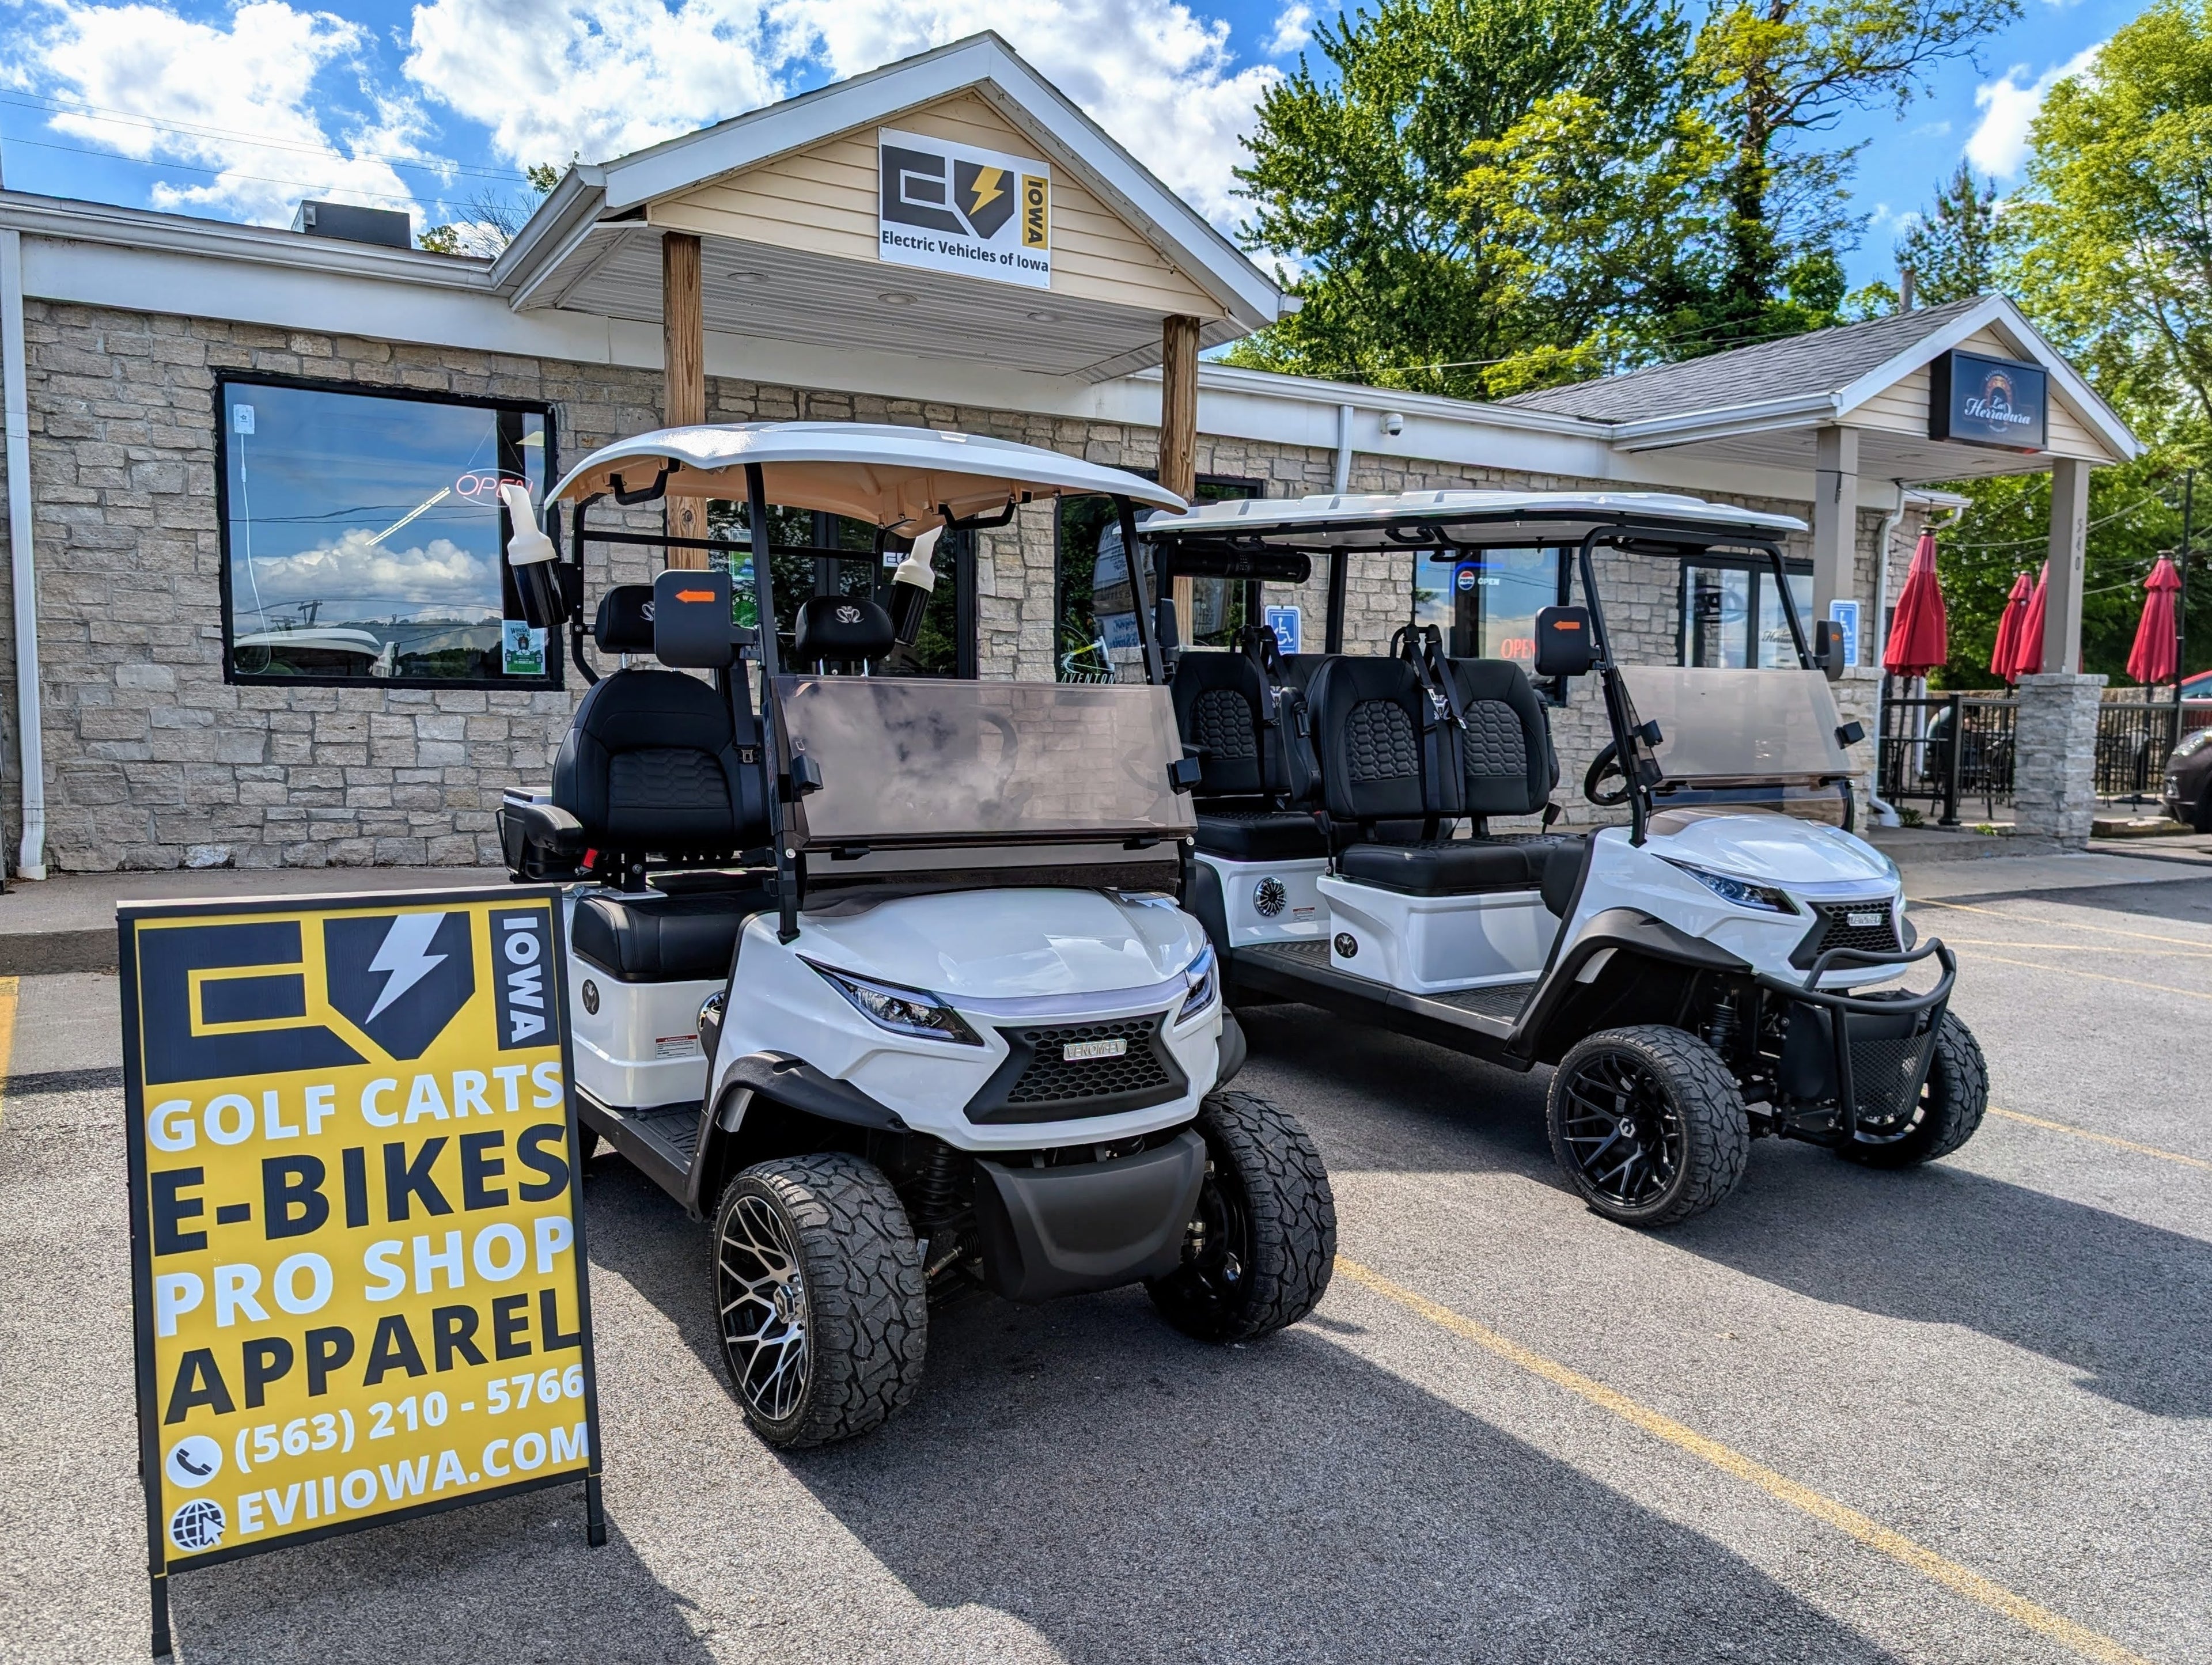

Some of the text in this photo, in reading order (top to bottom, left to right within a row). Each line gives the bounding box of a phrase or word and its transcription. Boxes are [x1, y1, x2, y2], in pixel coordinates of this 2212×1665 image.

[882, 230, 1049, 272] Electric Vehicles of Iowa
[1028, 180, 1043, 244] IOWA
[1964, 398, 2031, 424] Herradura
[1478, 578, 1500, 586] OPEN
[510, 627, 535, 635] WHISK
[1060, 673, 1116, 684] AVENTON
[503, 916, 546, 1044] IOWA
[147, 1061, 565, 1152] GOLF CARTS
[150, 1123, 570, 1257] E-BIKES
[155, 1216, 574, 1338] PRO SHOP
[164, 1288, 582, 1426] APPAREL
[235, 1409, 355, 1474] (563)
[368, 1390, 449, 1440] 210
[487, 1363, 585, 1415] 5766
[237, 1421, 590, 1535] EVIIOWA.COM
